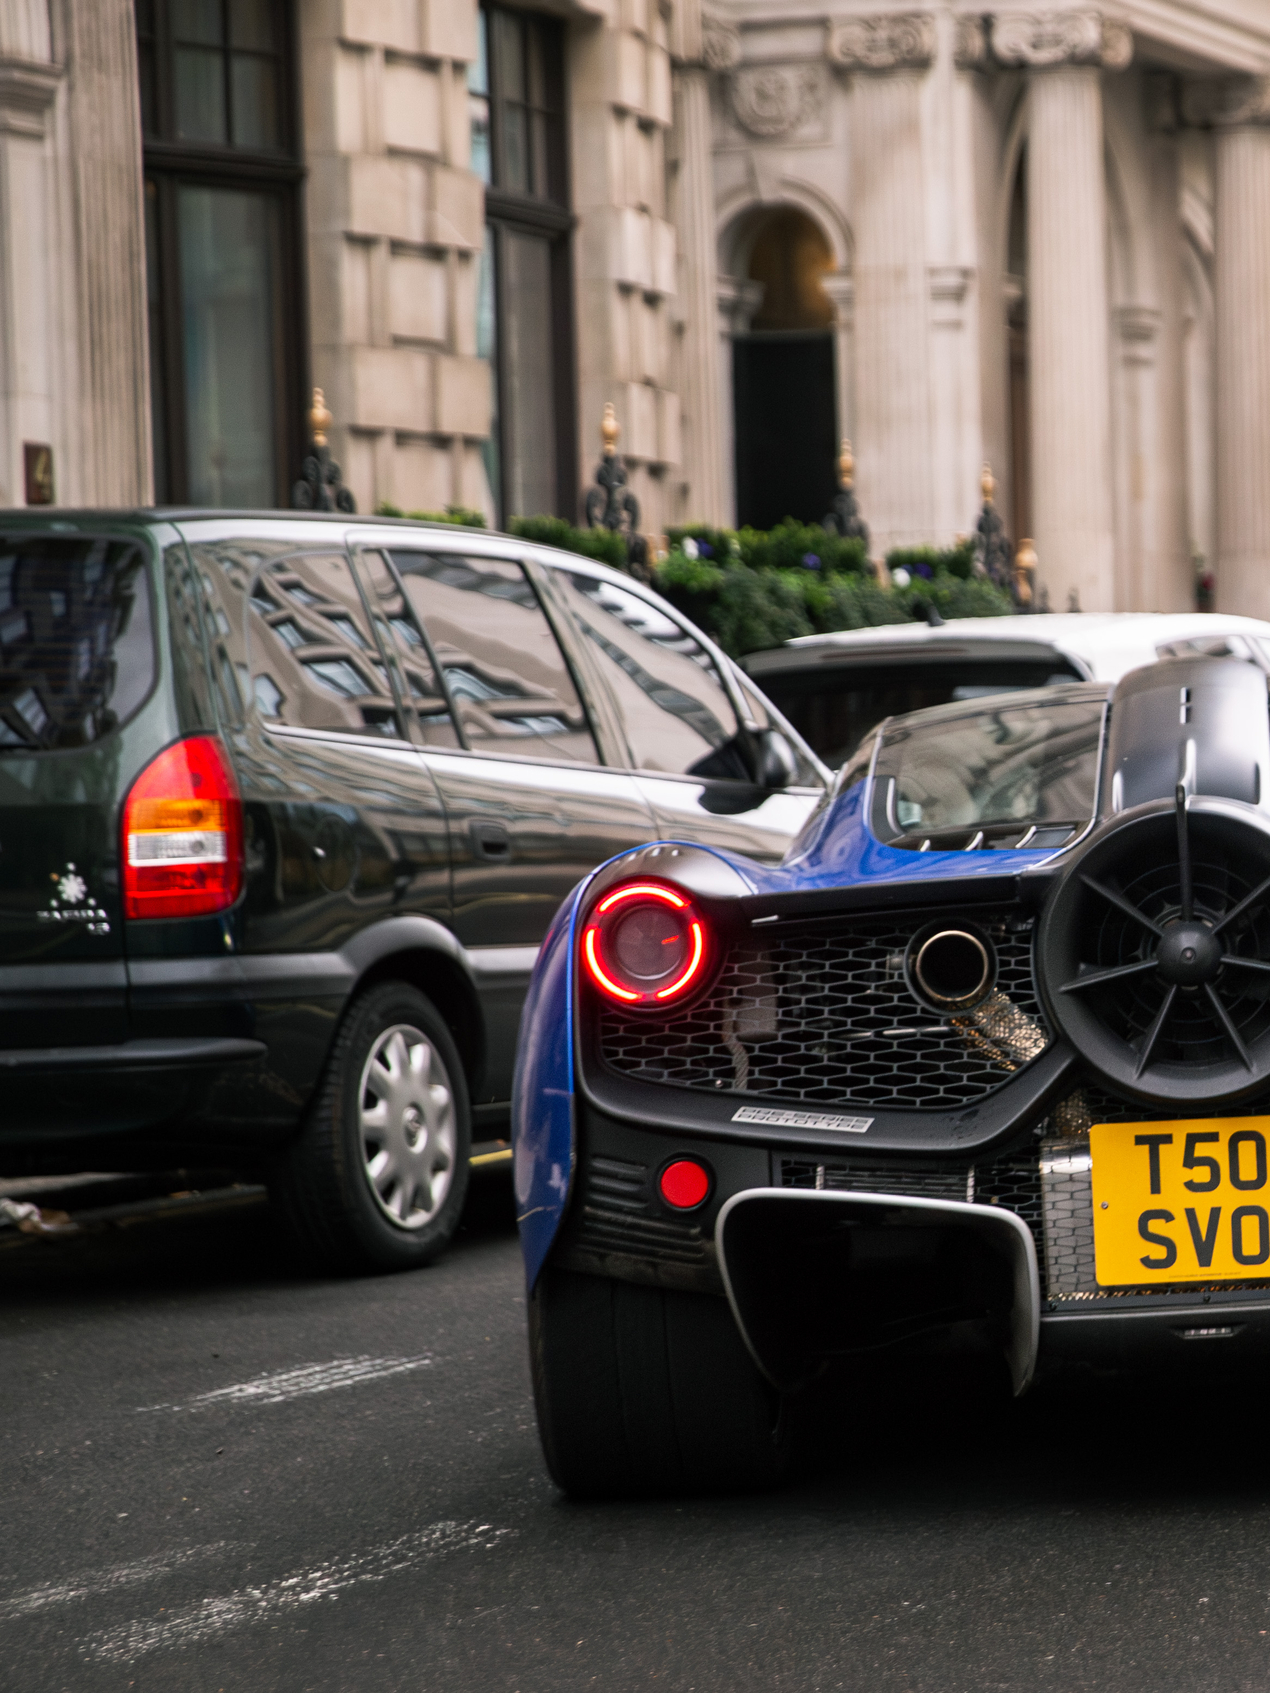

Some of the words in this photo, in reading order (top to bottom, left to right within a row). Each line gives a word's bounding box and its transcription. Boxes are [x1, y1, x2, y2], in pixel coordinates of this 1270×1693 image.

[738, 1112, 866, 1130] PROTOTYPE
[742, 1107, 869, 1124] PRE-SERIES
[1134, 1130, 1268, 1195] T50
[1137, 1205, 1270, 1270] SVO
